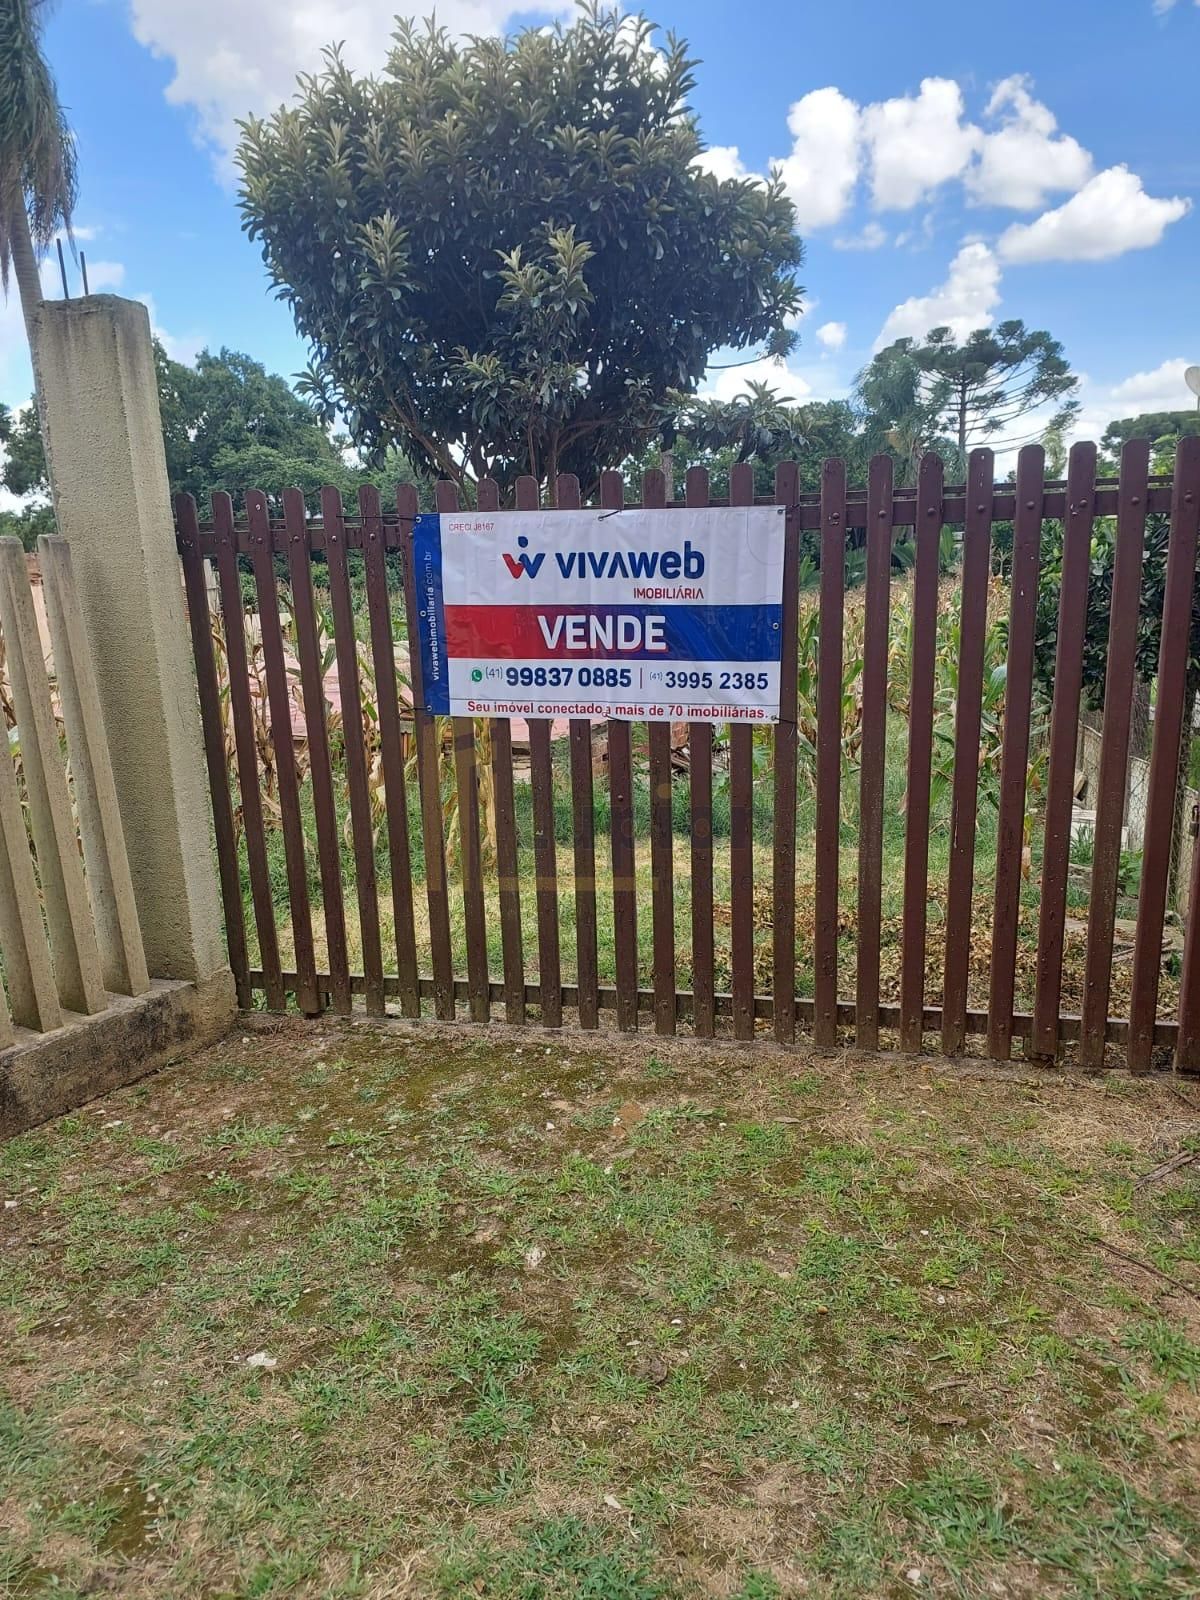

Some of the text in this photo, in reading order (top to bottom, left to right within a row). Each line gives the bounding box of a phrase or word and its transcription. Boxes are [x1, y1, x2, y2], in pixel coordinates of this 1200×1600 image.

[449, 523, 471, 531] CRECI
[633, 585, 704, 599] IMOBILIÁRIA
[537, 615, 667, 651] VENDE
[485, 666, 769, 690] (41) 99837 0885 (41) 3995 2385
[467, 700, 491, 712] Seu
[494, 700, 534, 713] imóvel
[537, 703, 603, 715] conectado
[615, 705, 645, 716] mais
[649, 706, 664, 716] de
[668, 706, 683, 717] 70
[687, 706, 769, 719] imobiliárias.
